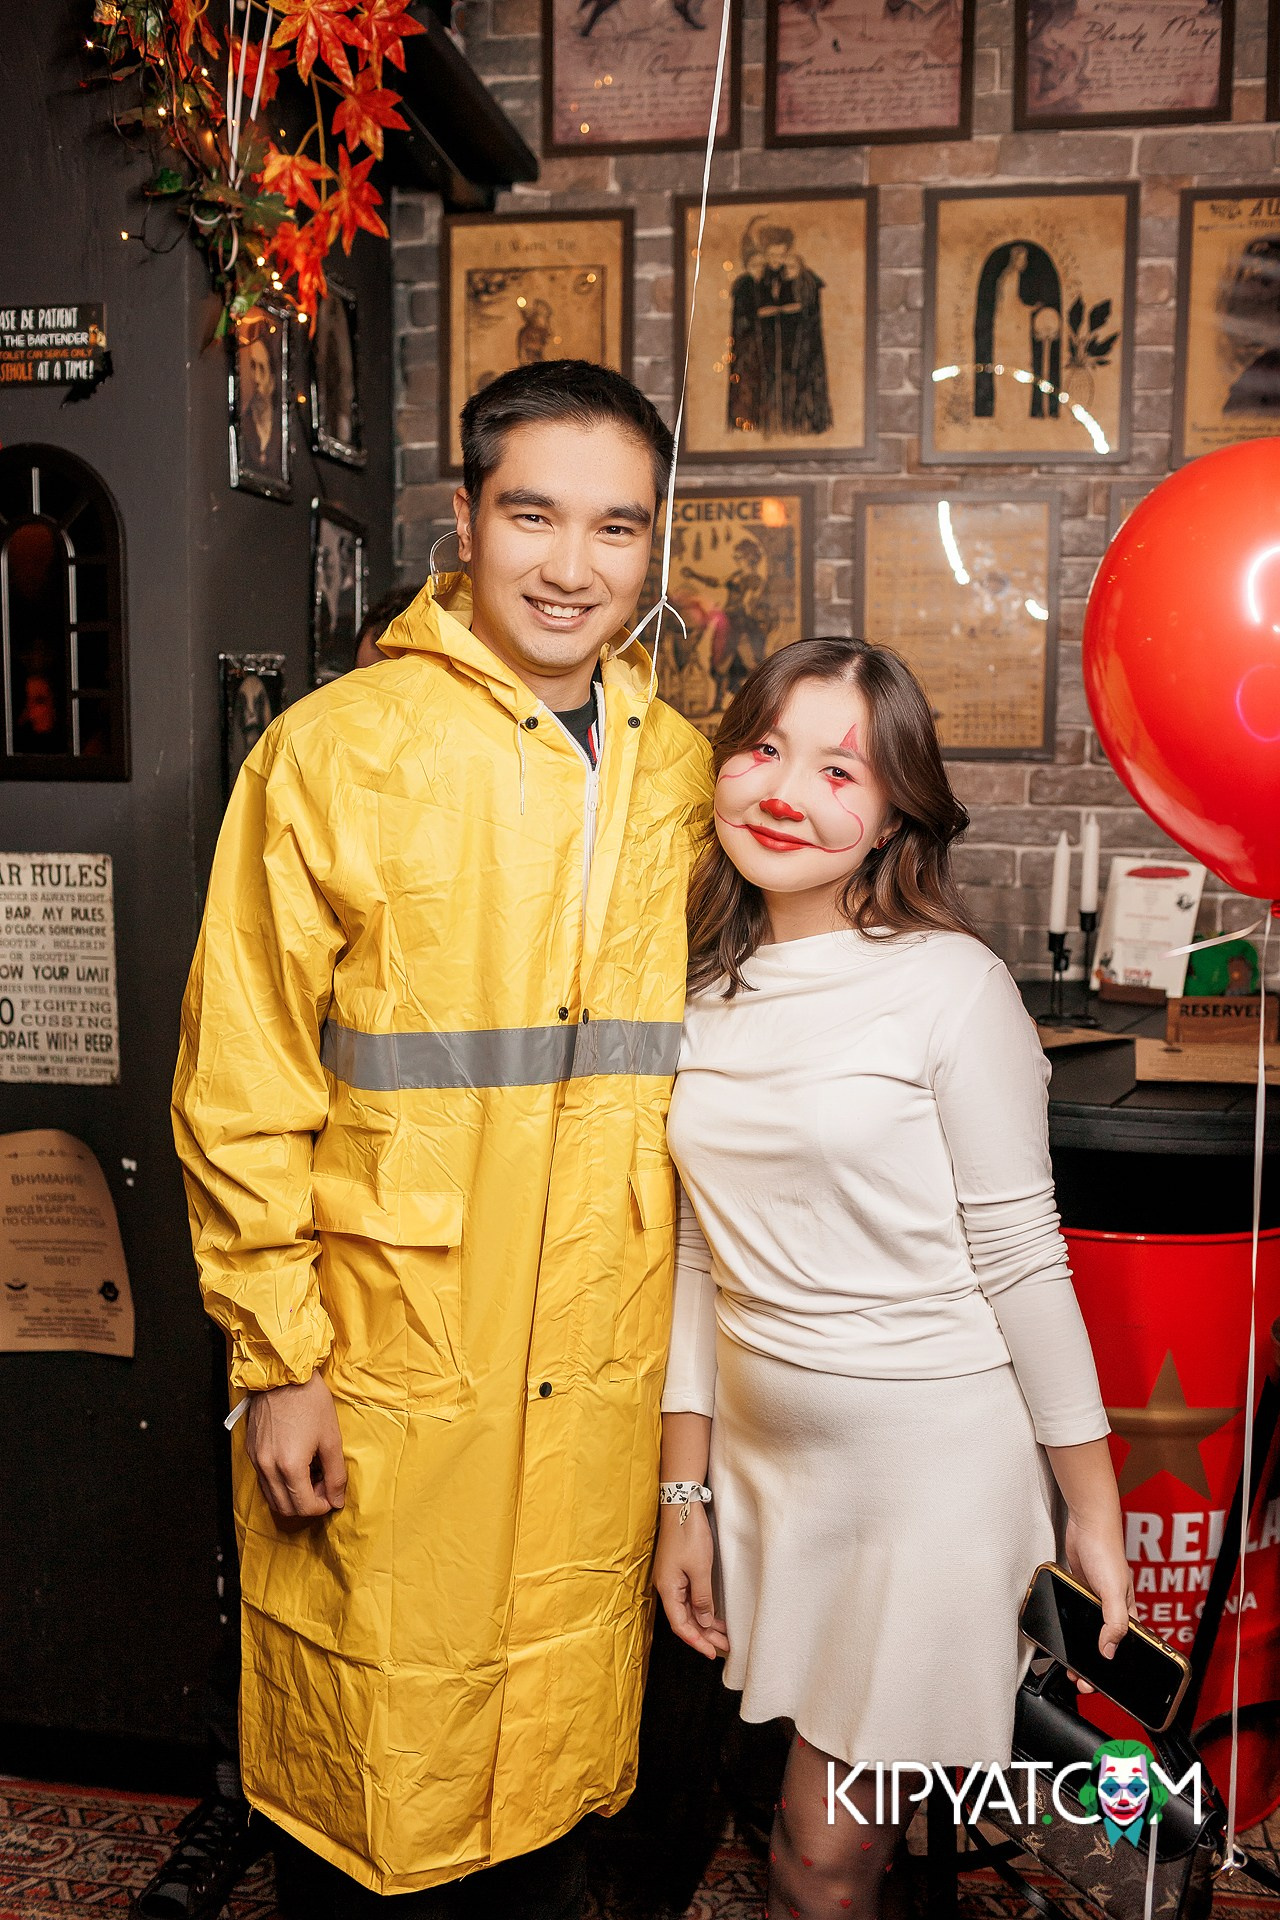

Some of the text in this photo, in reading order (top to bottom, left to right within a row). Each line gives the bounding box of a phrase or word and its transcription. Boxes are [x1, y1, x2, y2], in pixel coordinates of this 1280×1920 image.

[1079, 15, 1221, 53] Bloody Mary
[21, 309, 34, 330] BE
[39, 307, 78, 329] PATIENT
[3, 332, 89, 347] THE BARTENDER
[38, 361, 50, 380] AT
[53, 361, 61, 380] A
[65, 360, 95, 380] TIME!
[30, 863, 107, 887] RULES
[42, 906, 63, 921] MY
[71, 907, 105, 922] RULES
[33, 965, 69, 981] YOUR
[76, 967, 110, 983] LIMIT
[21, 999, 112, 1015] FIGHTING
[21, 1014, 112, 1031] CUSSING
[46, 1031, 79, 1052] WITH
[85, 1032, 113, 1053] BEER
